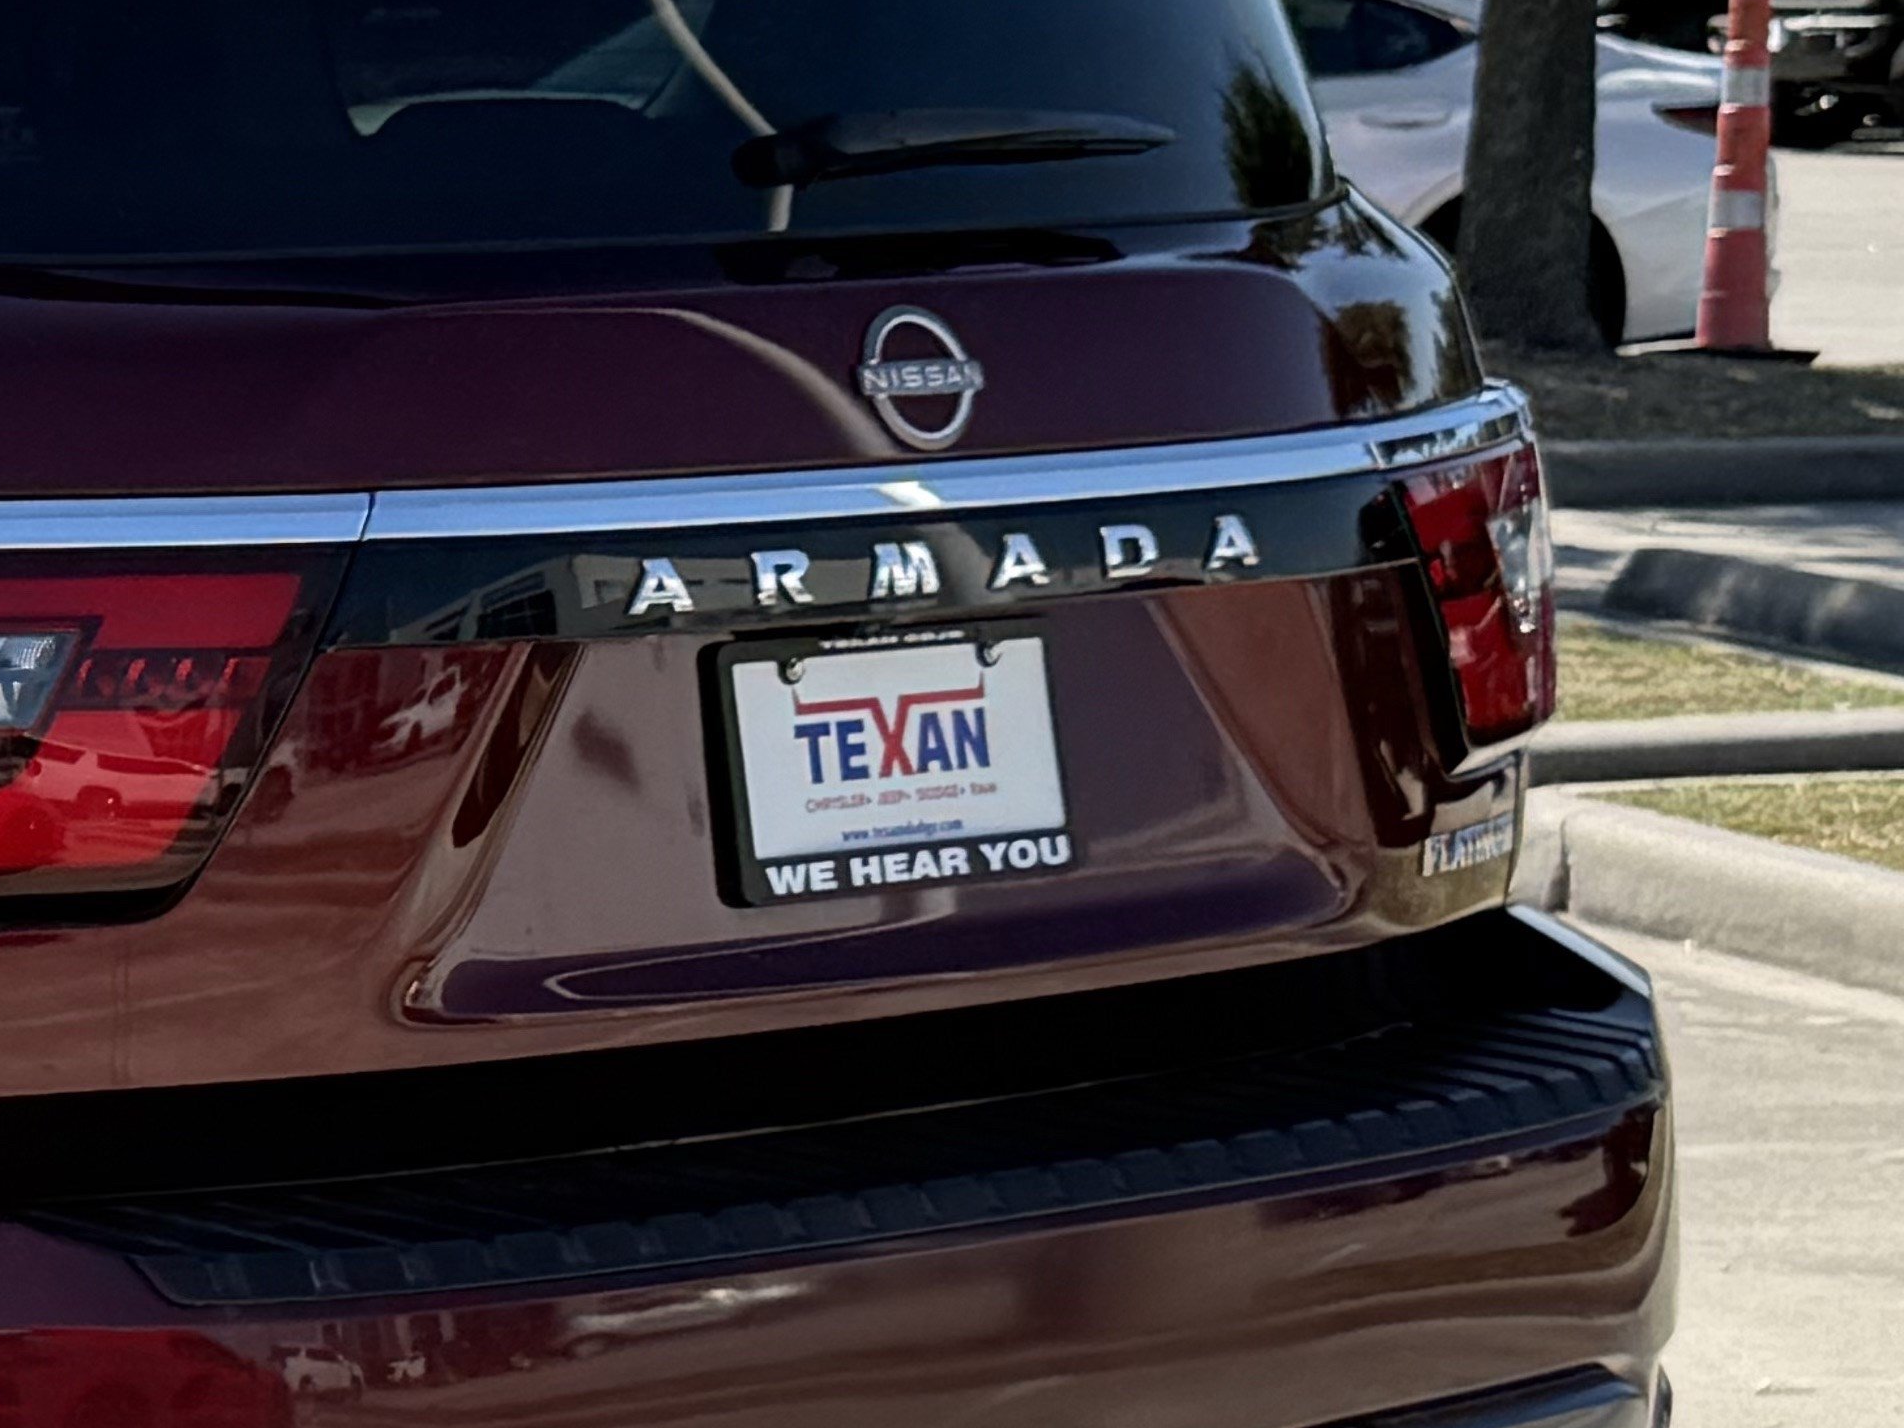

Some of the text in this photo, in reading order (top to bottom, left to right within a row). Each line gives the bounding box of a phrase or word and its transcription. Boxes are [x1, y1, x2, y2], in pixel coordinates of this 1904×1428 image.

[863, 361, 983, 391] NISSAN
[628, 514, 1259, 616] ARMADA
[794, 687, 990, 785] TEXAN
[765, 834, 1072, 896] WE HEAR YOU
